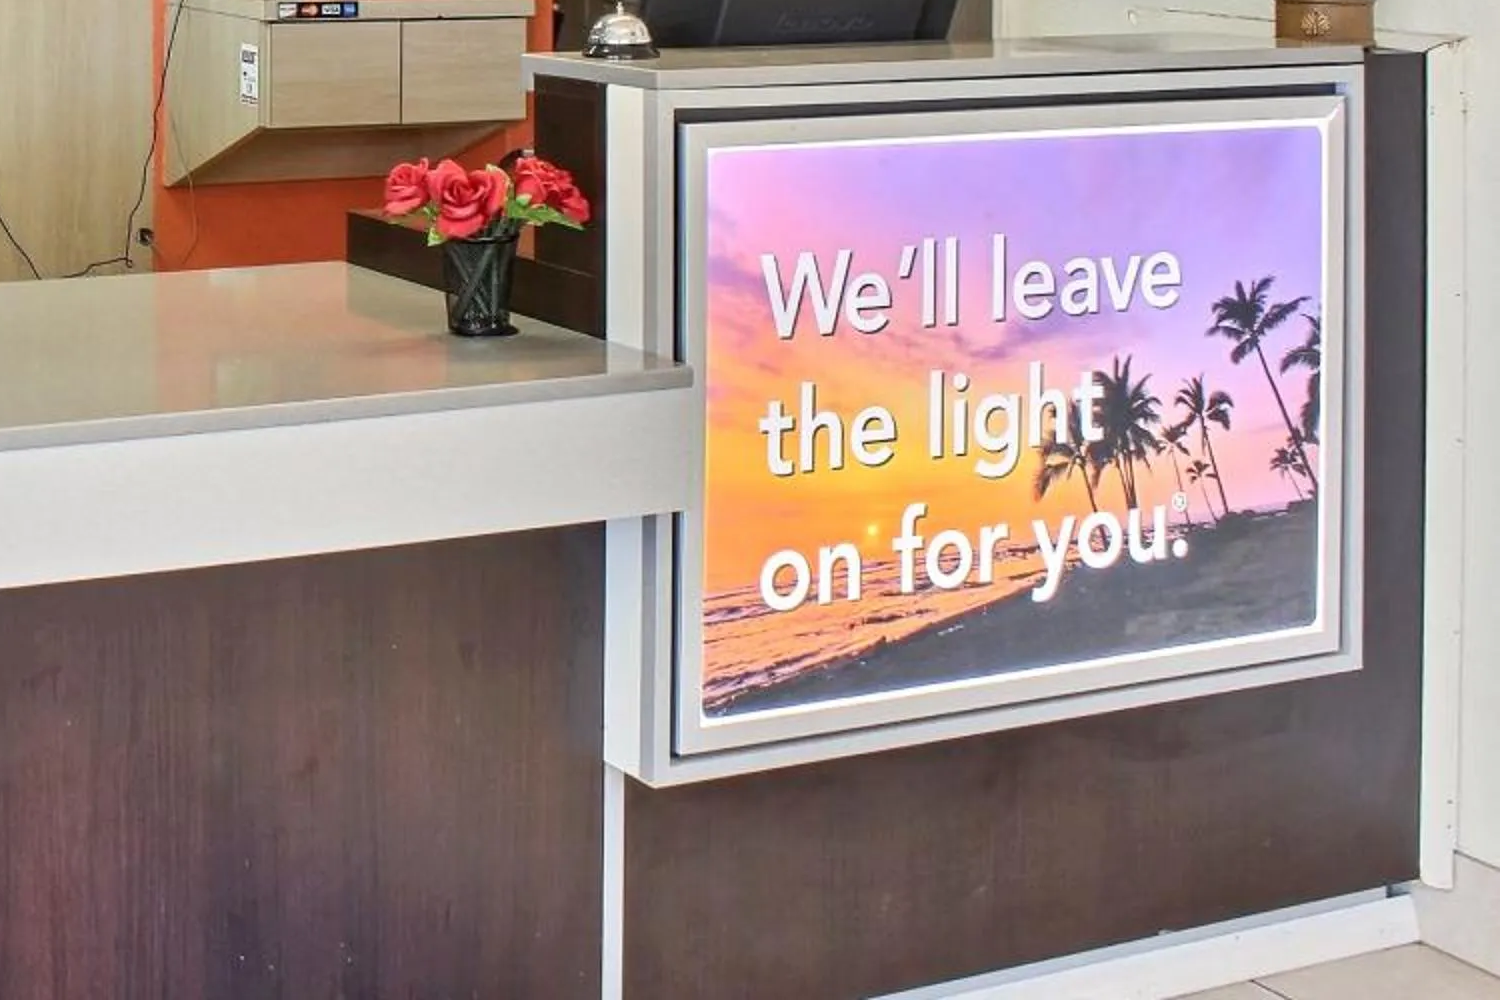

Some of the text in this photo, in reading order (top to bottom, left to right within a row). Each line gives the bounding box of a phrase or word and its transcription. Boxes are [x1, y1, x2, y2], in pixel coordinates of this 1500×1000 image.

[760, 233, 1183, 340] We'll leave
[759, 360, 1106, 479] the light
[759, 540, 862, 612] on
[891, 503, 1010, 594] for
